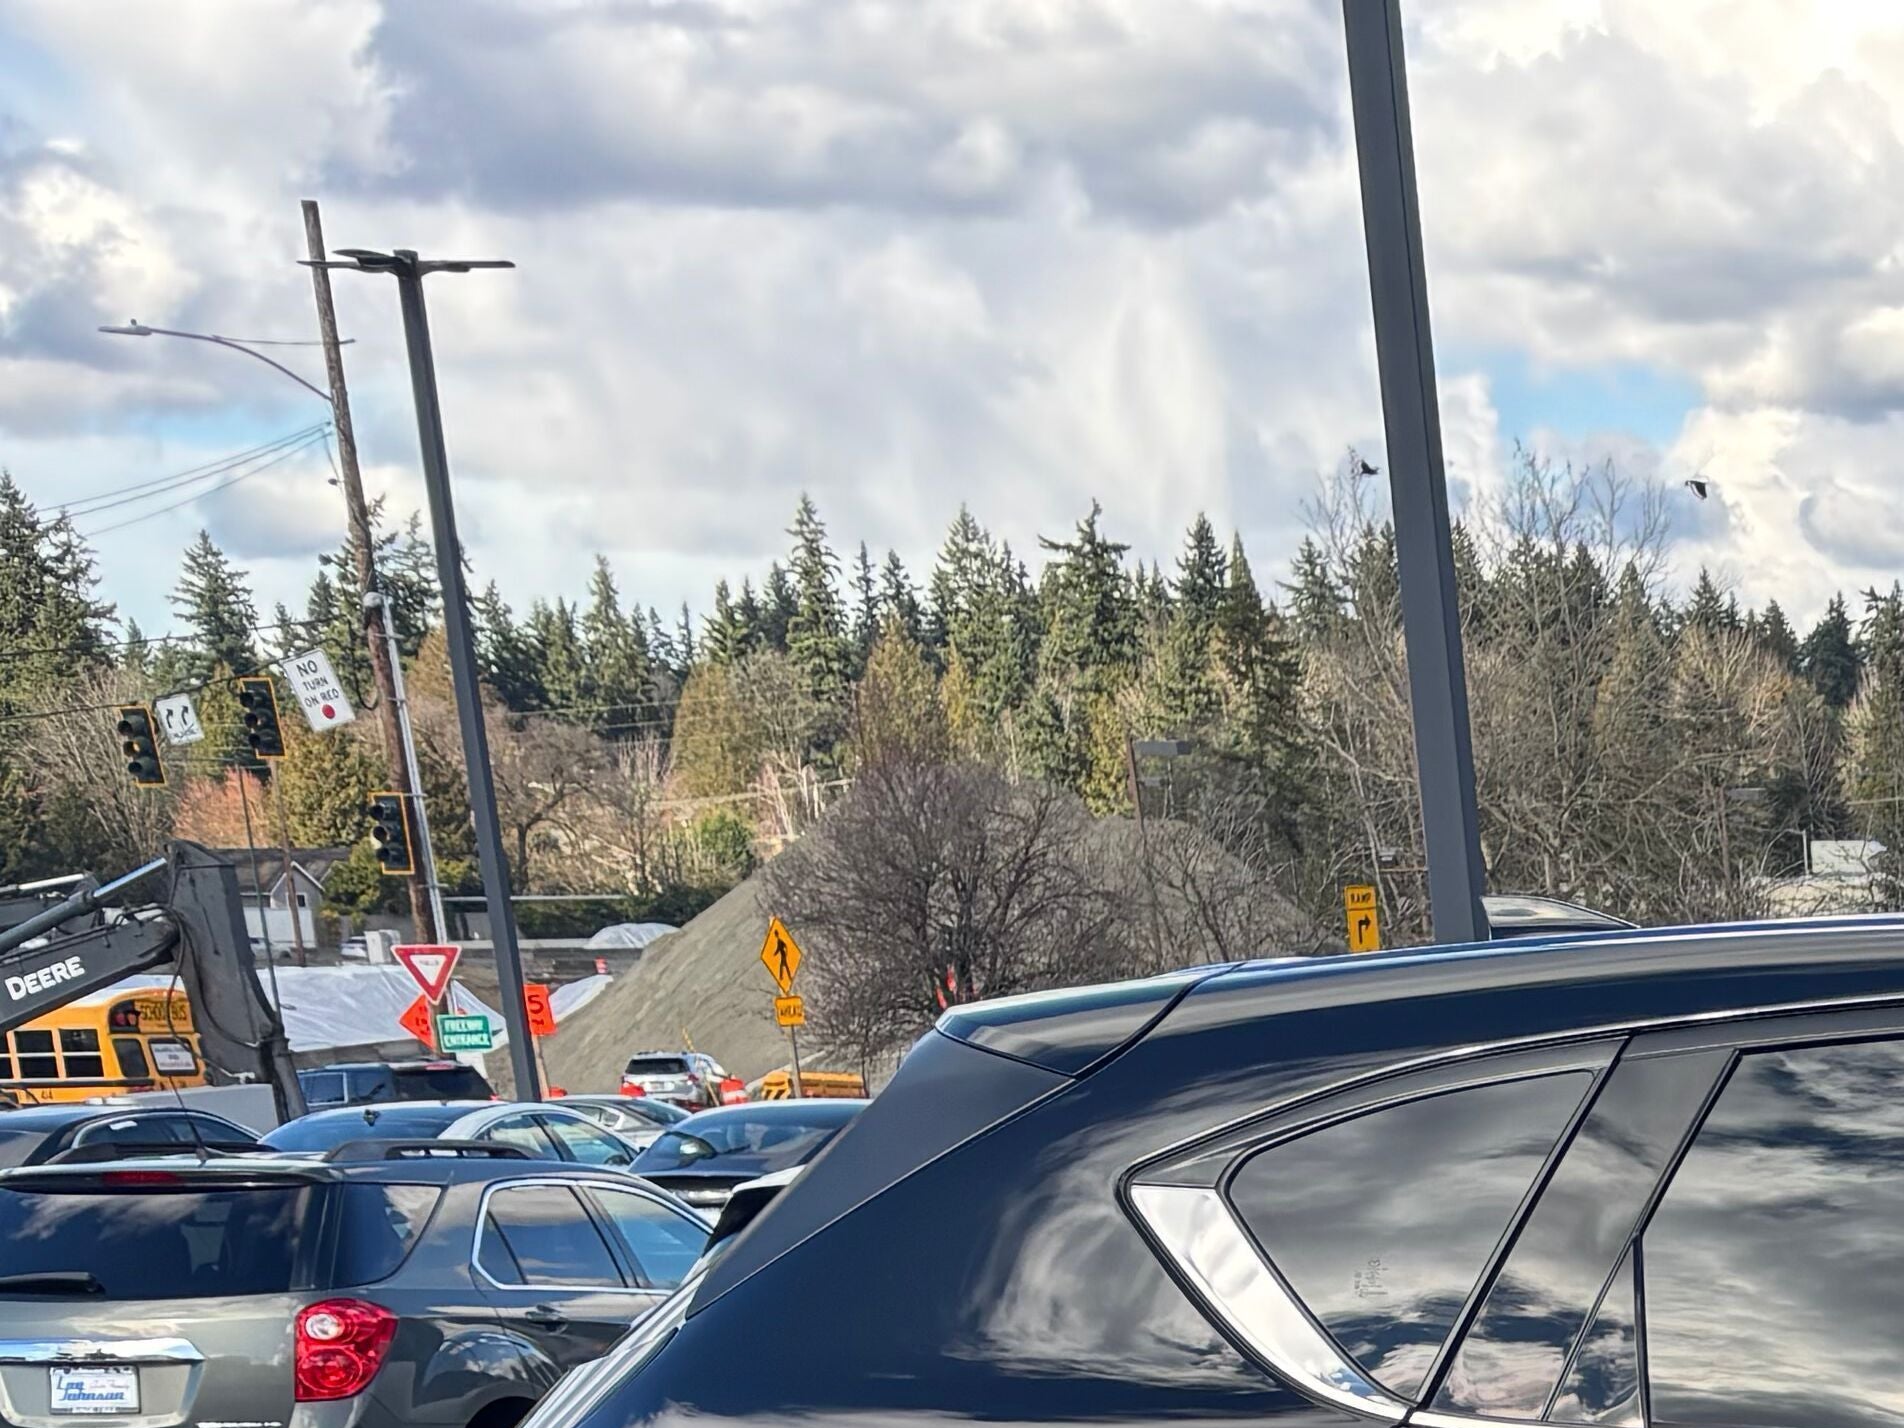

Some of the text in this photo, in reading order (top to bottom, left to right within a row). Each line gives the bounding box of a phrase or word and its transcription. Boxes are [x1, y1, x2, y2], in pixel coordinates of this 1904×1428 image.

[296, 660, 318, 677] NO
[302, 676, 329, 691] TURN
[304, 688, 340, 708] ON RED
[5, 956, 85, 1000] DEERE
